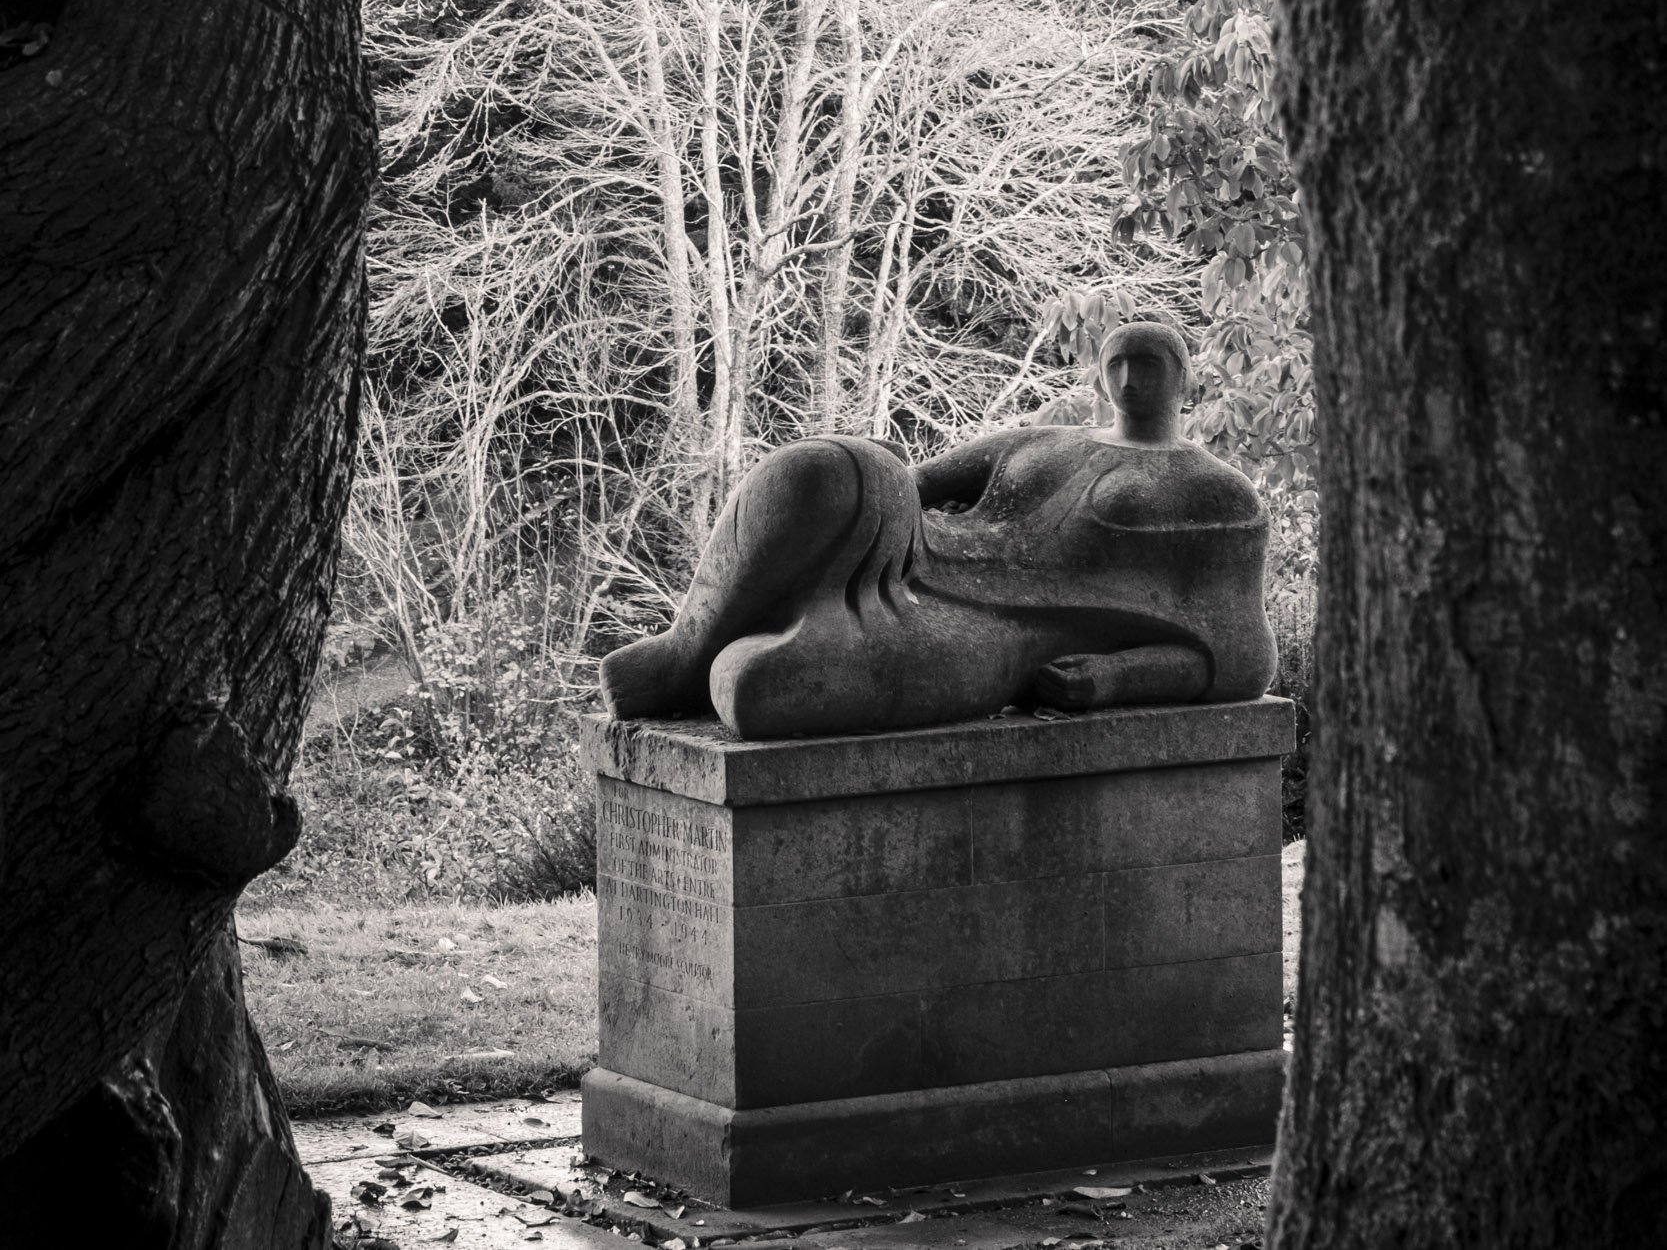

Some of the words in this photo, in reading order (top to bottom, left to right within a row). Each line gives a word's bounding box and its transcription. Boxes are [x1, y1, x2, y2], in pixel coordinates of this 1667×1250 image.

[603, 800, 680, 841] CHRISTOPHER
[682, 821, 727, 853] MARTIN
[610, 832, 635, 853] FIRST
[638, 839, 718, 875] ADMINISTRATOR
[613, 857, 627, 874] OF
[627, 860, 649, 880] THE
[650, 867, 675, 888] ARTS
[676, 875, 716, 899] CENTRE
[621, 881, 692, 916] DARTINGTON
[694, 902, 721, 924] HALL
[620, 905, 653, 929] 1934
[674, 921, 708, 946] 1944
